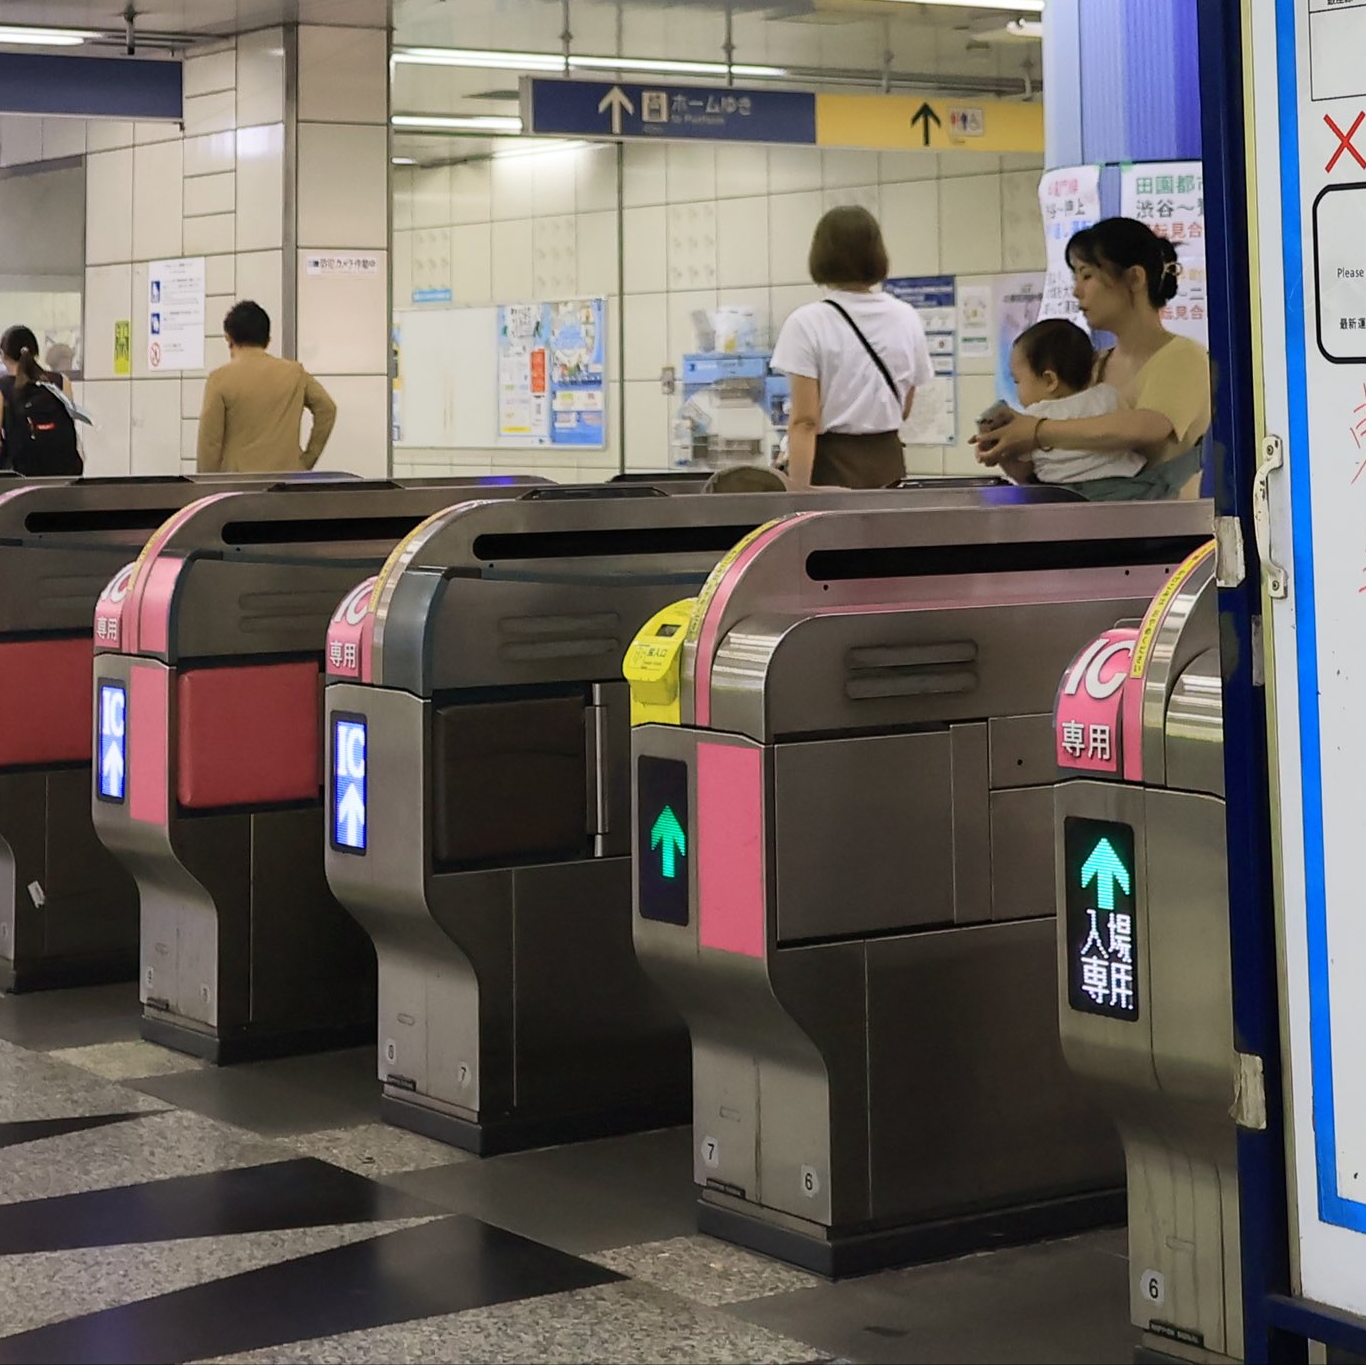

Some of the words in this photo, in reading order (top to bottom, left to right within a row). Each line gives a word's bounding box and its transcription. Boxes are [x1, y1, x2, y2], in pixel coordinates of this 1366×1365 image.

[1136, 175, 1203, 195] 田園都
[1136, 198, 1203, 219] 渋谷～
[1337, 267, 1364, 279] Please
[97, 616, 117, 640] 専用
[329, 641, 356, 668] 専用
[1065, 638, 1136, 699] IC
[102, 690, 125, 737] IC
[1061, 720, 1111, 760] 専用
[337, 725, 365, 778] IC
[707, 1142, 715, 1160] 7
[804, 1173, 813, 1191] 6
[1148, 1278, 1158, 1299] 6
